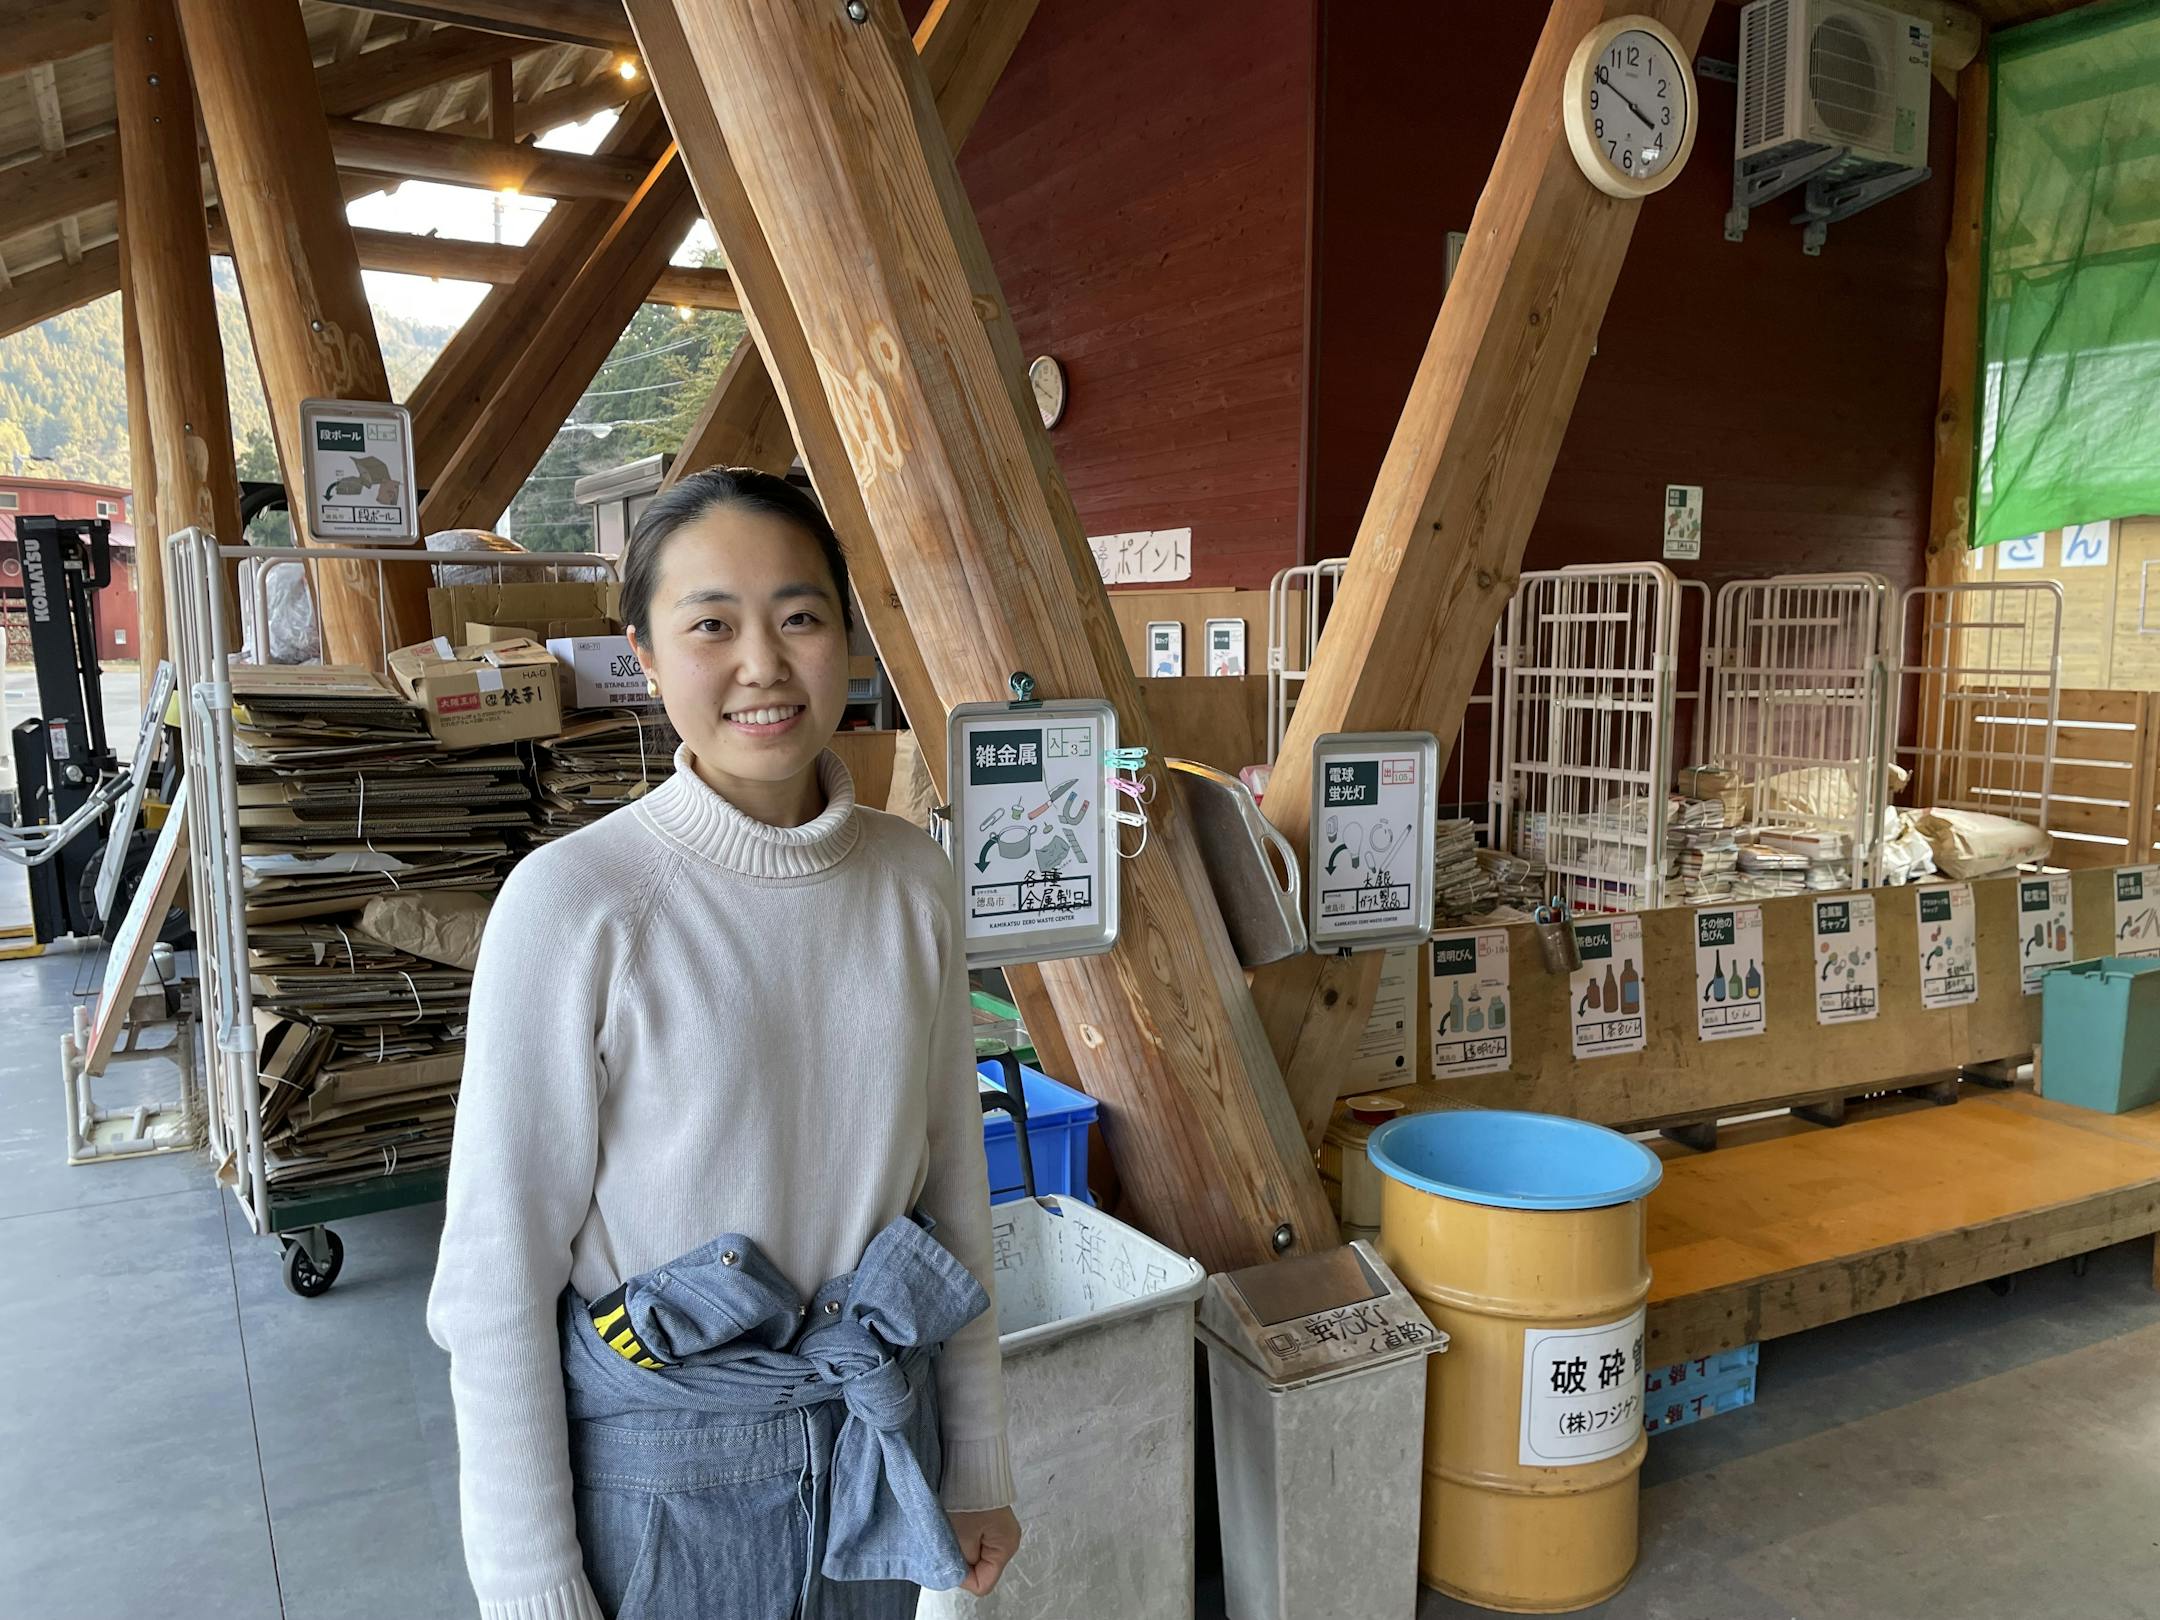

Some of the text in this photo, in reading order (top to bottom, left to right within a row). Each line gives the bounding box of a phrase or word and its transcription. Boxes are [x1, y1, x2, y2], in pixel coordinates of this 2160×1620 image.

[1610, 49, 1622, 69] 11
[1627, 45, 1640, 67] 12
[1595, 64, 1609, 85] 10
[1648, 57, 1653, 76] 1
[1657, 79, 1667, 98] 2
[1590, 91, 1599, 110] 9
[1661, 106, 1670, 125] 3
[1595, 119, 1604, 138] 8
[1608, 141, 1617, 159] 7
[1653, 132, 1664, 150] 4
[1622, 150, 1632, 169] 6
[320, 429, 361, 440] 段ボール
[358, 508, 395, 523] 段ボール
[24, 539, 50, 622] KOMATSU
[1050, 738, 1060, 749] 入
[1071, 744, 1078, 755] 3
[976, 743, 1037, 768] 雑金属
[1329, 767, 1354, 783] 電球
[1328, 784, 1366, 801] 蛍光灯
[1024, 868, 1063, 888] 各種
[976, 897, 1005, 908] 徳島市
[1021, 889, 1092, 915] 金属製品
[1819, 906, 1843, 918] 金属製
[989, 921, 1021, 929] KAMIKATSU
[1700, 917, 1732, 930] その他の
[1820, 917, 1848, 930] キャップ
[1577, 934, 1609, 947] 茶色びん
[1701, 929, 1725, 942] 色びん
[1437, 949, 1472, 963] 透明びん
[1305, 1304, 1389, 1344] 蛍光灯
